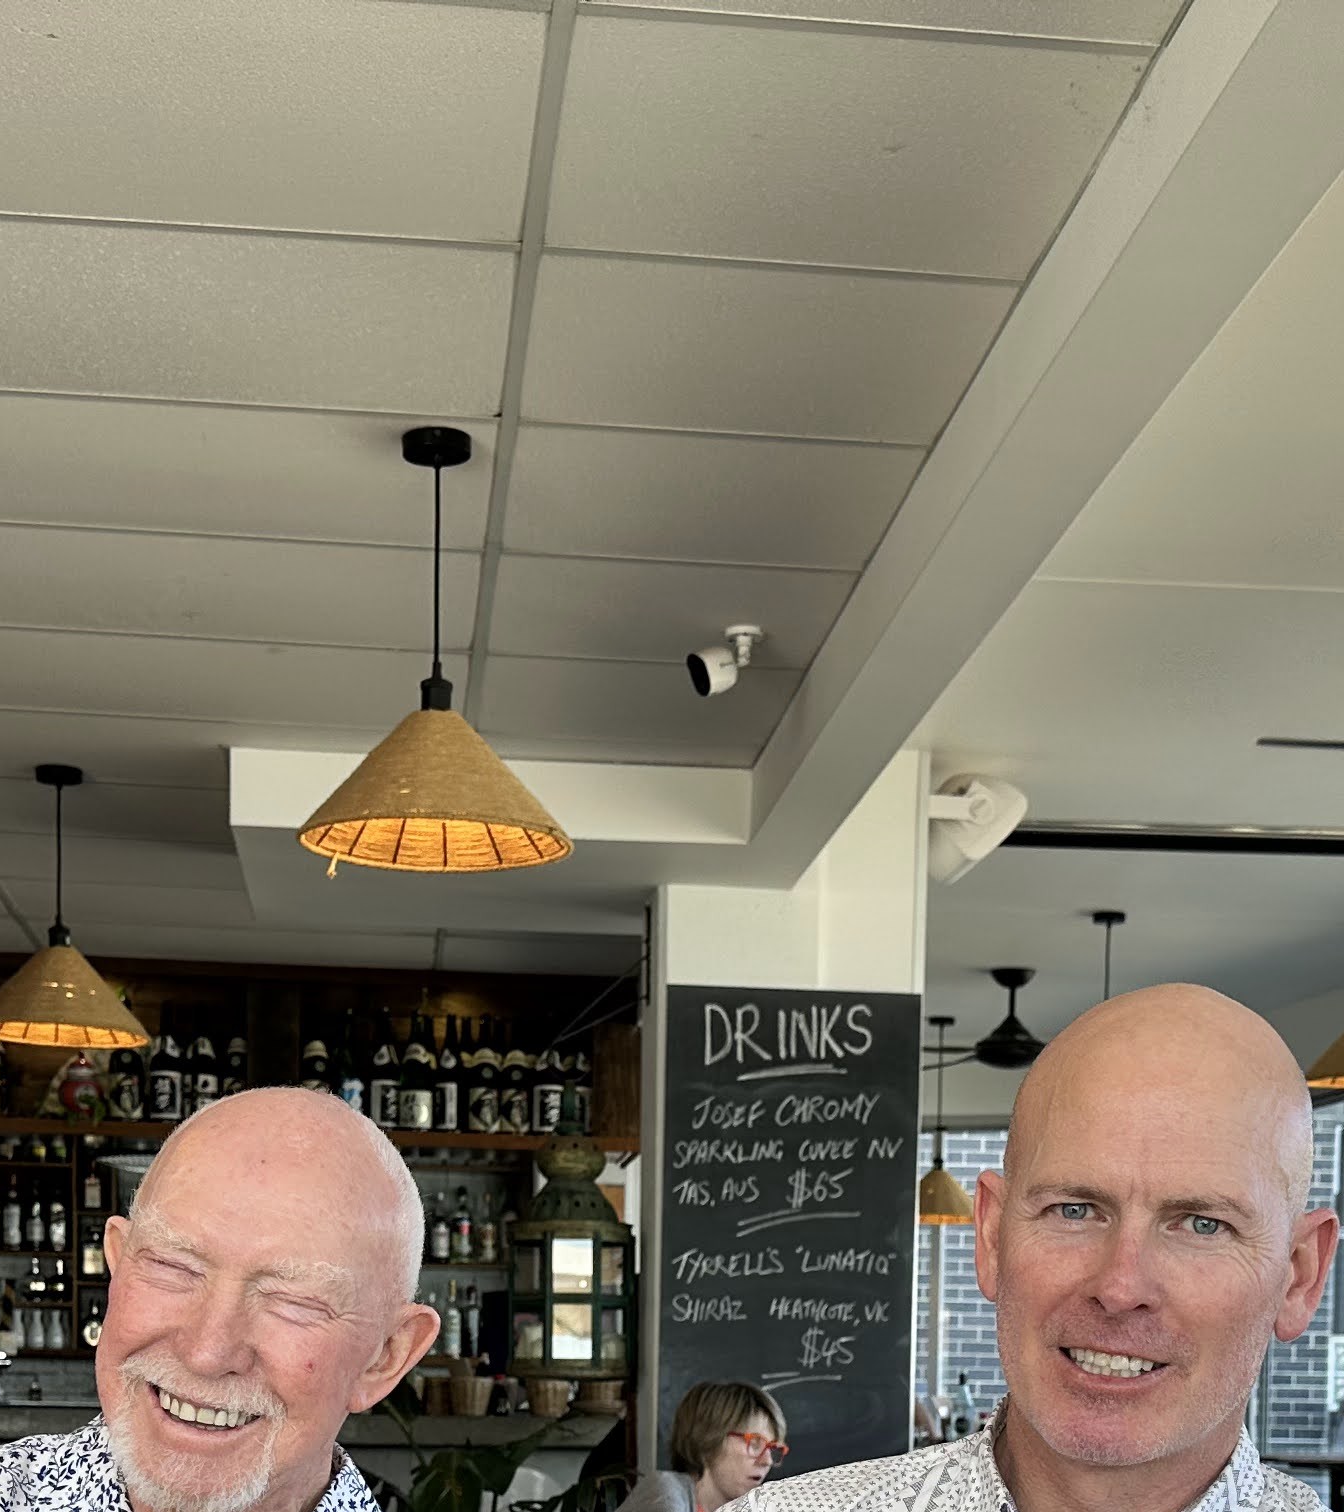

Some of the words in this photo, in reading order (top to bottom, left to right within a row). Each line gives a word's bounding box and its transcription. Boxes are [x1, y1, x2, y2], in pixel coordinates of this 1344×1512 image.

[703, 1002, 873, 1066] DRINKS
[691, 1095, 766, 1130] JOSEF
[774, 1092, 881, 1127] CHROMY
[672, 1138, 785, 1170] SPARKLING
[866, 1136, 904, 1160] NV
[720, 1175, 761, 1203] AUS
[785, 1166, 854, 1209] $65
[671, 1246, 785, 1285] TYRRELL'S
[671, 1292, 747, 1324] SHIRAZ
[797, 1326, 857, 1369] $45
